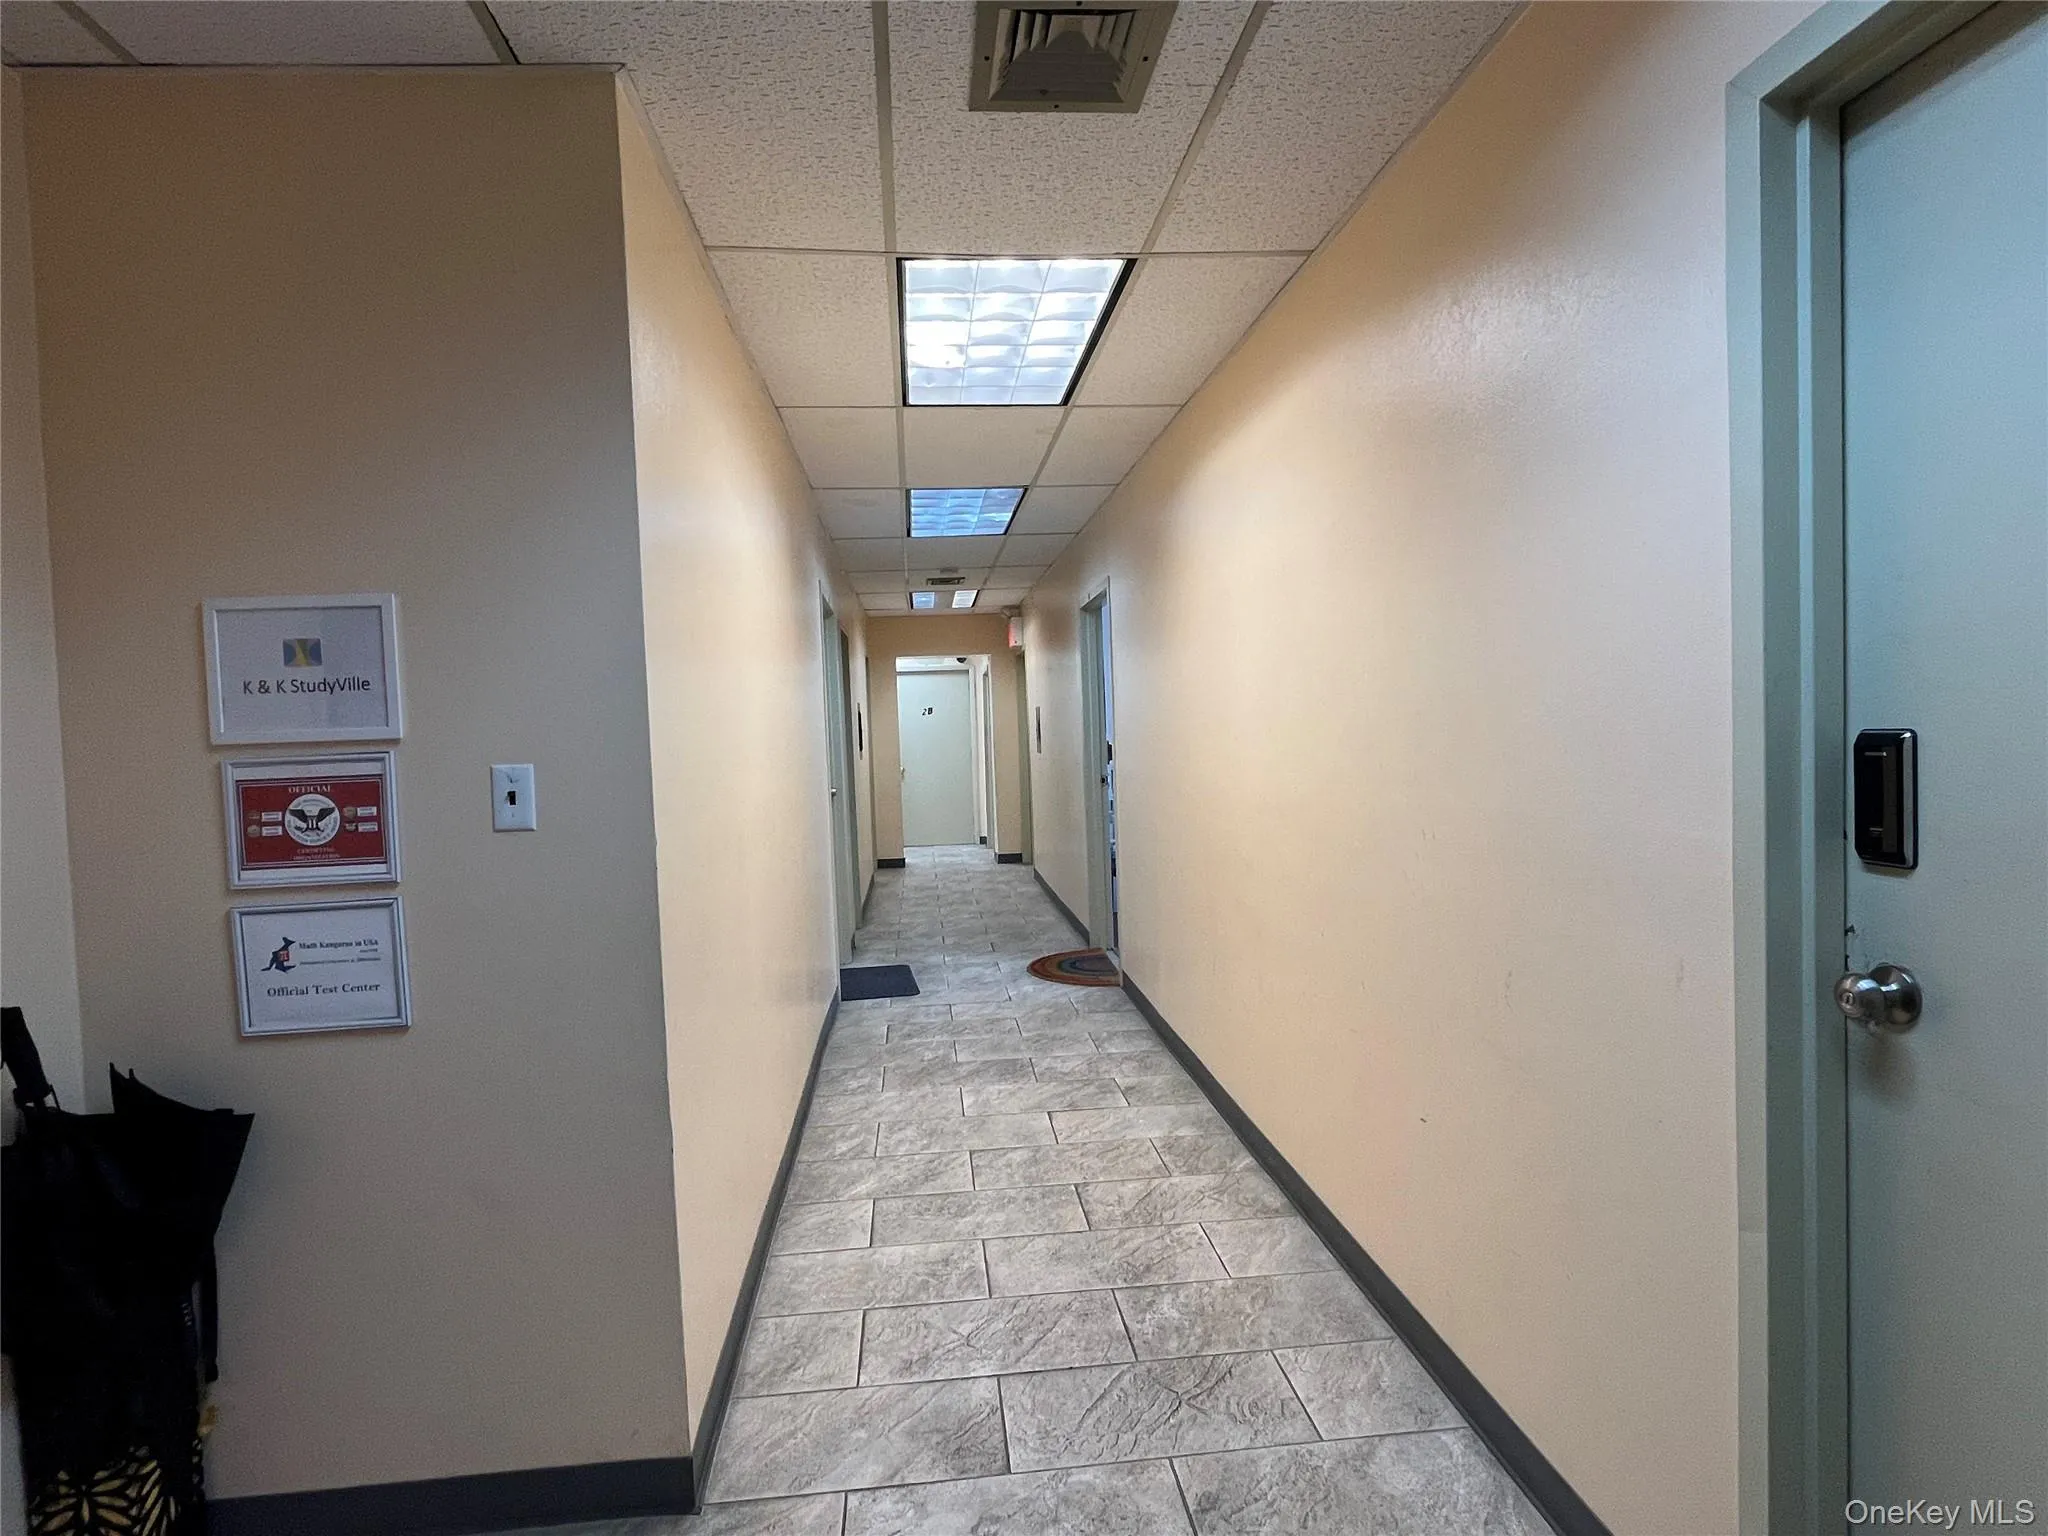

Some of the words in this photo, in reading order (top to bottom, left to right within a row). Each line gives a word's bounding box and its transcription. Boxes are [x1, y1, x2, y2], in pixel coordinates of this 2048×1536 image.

[243, 680, 253, 695] K
[257, 680, 271, 694] &
[276, 679, 287, 694] K
[290, 676, 371, 695] StudyVille
[363, 938, 378, 947] USA
[267, 986, 309, 997] Official
[312, 984, 338, 995] Test
[341, 983, 380, 993] Center
